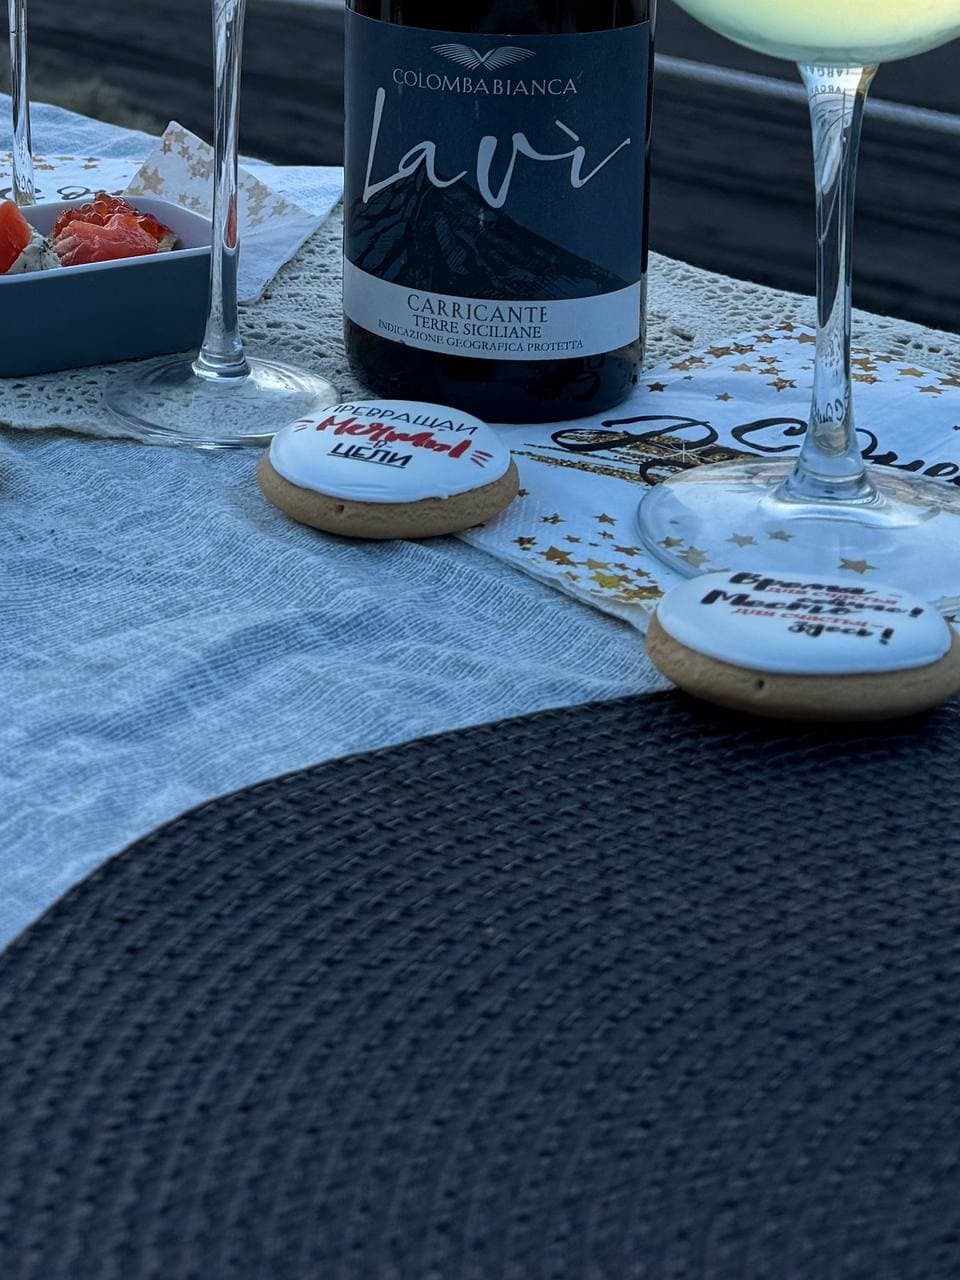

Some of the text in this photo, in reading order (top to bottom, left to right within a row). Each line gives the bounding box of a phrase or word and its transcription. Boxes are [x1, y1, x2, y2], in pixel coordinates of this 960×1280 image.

[406, 293, 549, 324] CARRICANTE
[378, 319, 584, 352] INDICAZIONE GEOGRAFICA PROTETTA
[413, 314, 542, 339] TERRE SICILIANE
[330, 442, 413, 468] ЦЕЛИ
